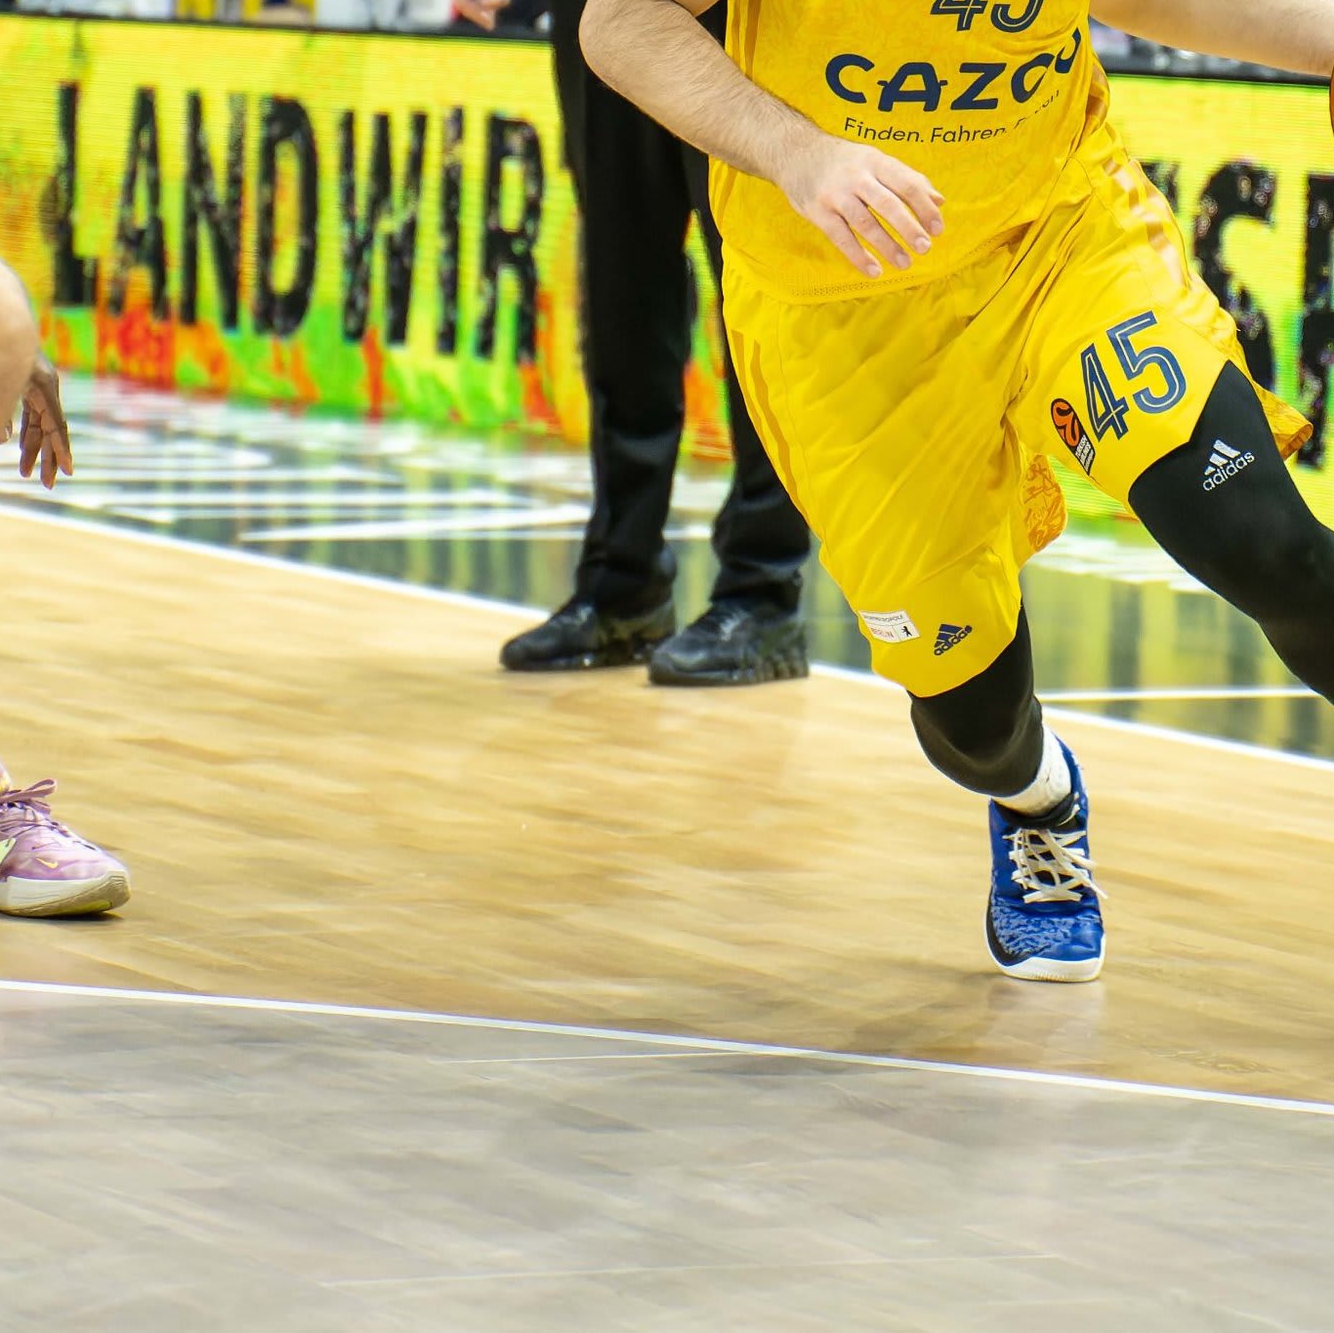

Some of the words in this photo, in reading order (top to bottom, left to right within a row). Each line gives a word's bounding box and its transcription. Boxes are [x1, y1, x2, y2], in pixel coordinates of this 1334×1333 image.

[844, 117, 925, 143] Finden.
[1079, 310, 1187, 442] 45
[1202, 452, 1256, 492] adidas
[933, 624, 973, 656] adidas
